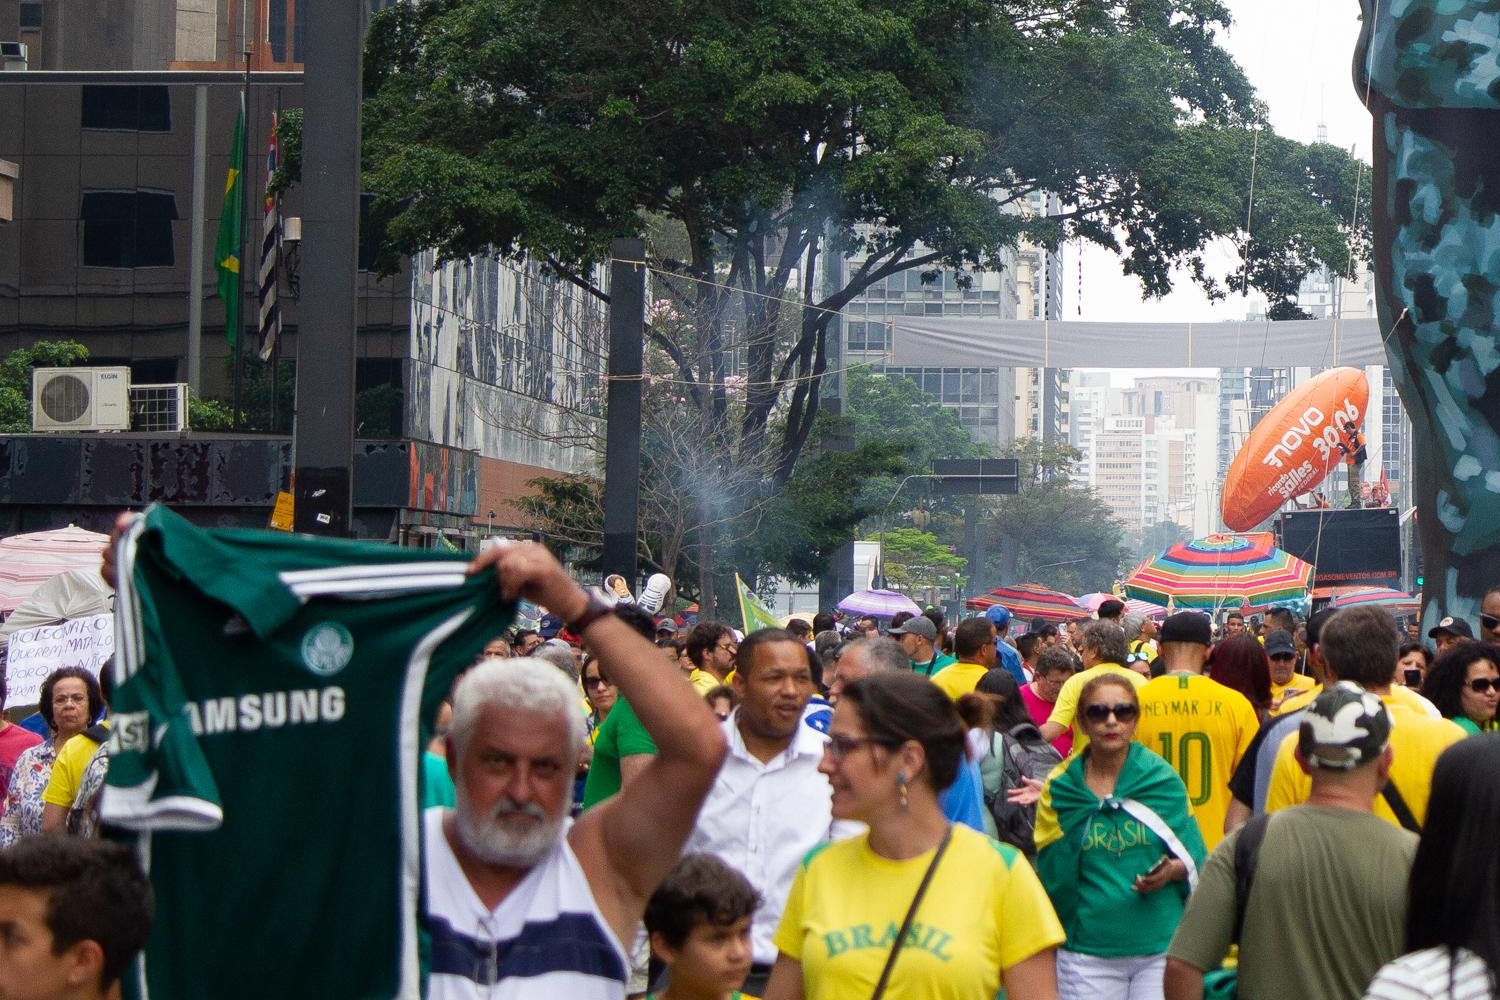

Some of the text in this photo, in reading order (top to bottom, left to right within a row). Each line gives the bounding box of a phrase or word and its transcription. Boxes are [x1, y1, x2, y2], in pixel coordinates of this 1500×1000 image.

[1145, 699, 1222, 718] NEYMAR JR
[1159, 732, 1212, 807] 10
[824, 920, 954, 962] BRASIL
